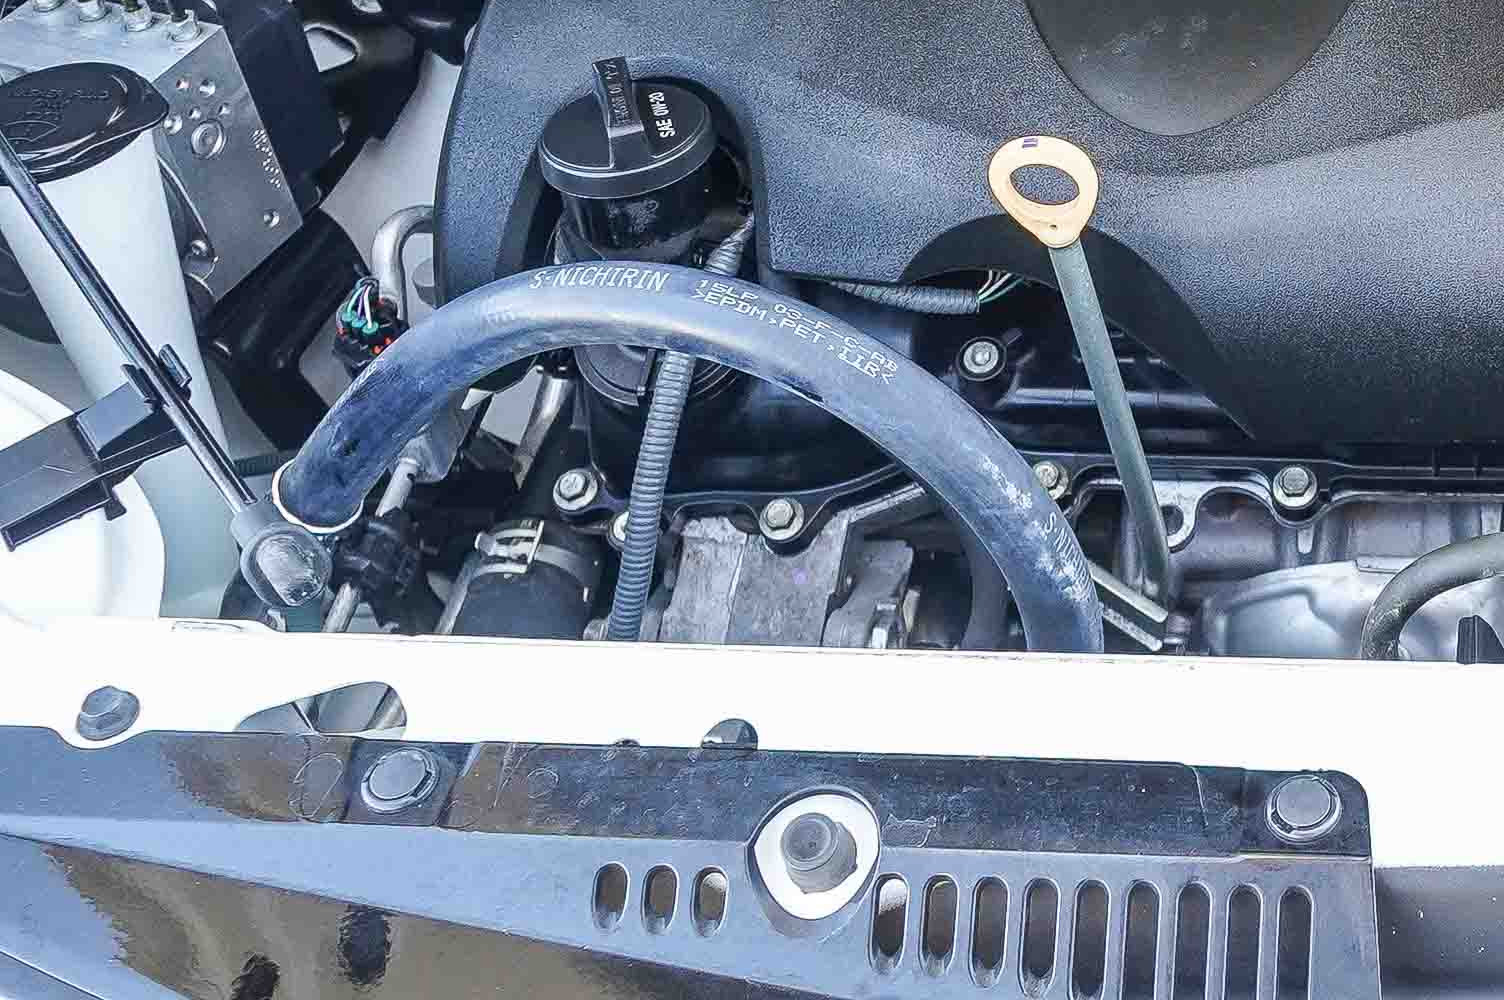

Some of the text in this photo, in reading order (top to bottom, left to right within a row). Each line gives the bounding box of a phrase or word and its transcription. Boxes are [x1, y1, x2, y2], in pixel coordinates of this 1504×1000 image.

[648, 91, 676, 138] SAE 0W-20
[529, 265, 671, 292] S-NICHIRIN
